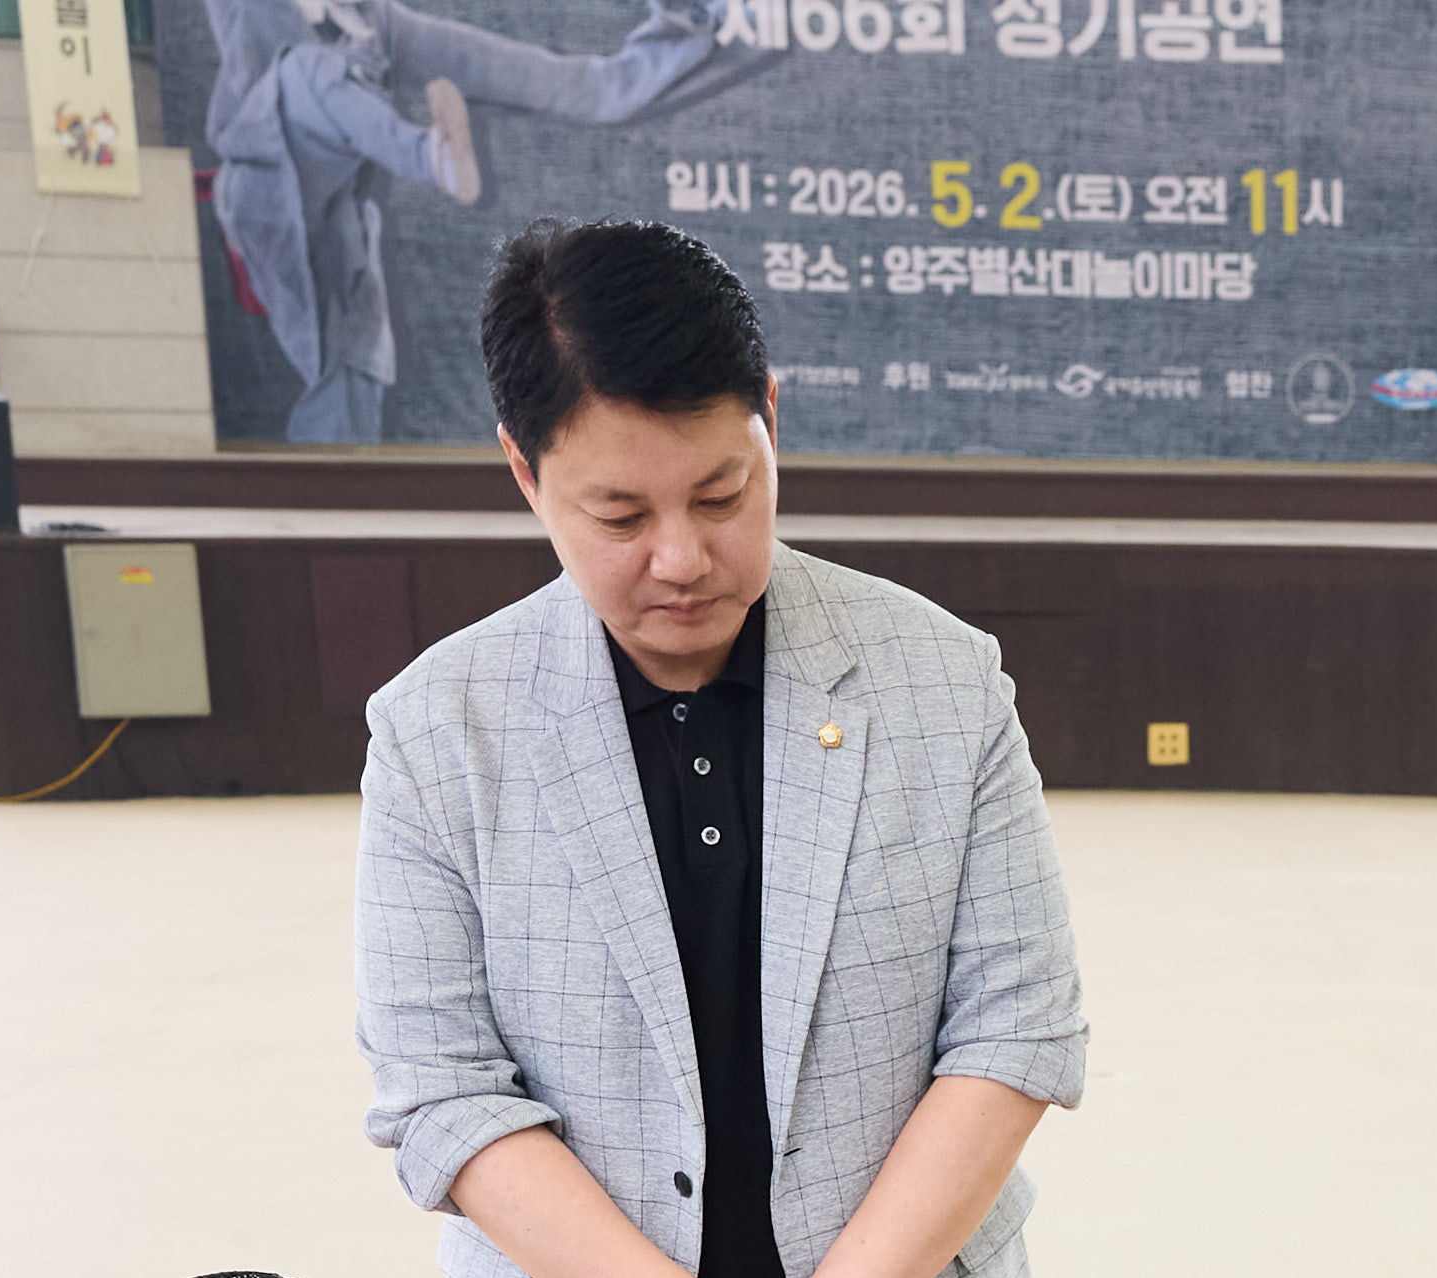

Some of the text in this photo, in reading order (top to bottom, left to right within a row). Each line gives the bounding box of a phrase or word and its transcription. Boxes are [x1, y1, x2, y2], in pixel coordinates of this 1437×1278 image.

[991, 0, 1285, 63] 정기공연
[665, 161, 751, 213] 일시
[788, 166, 919, 217] 2026.
[1143, 175, 1229, 226] 오전
[1241, 168, 1344, 236] 11시
[763, 242, 851, 292] 장소
[883, 245, 1258, 301] 양주별산대놀이마당
